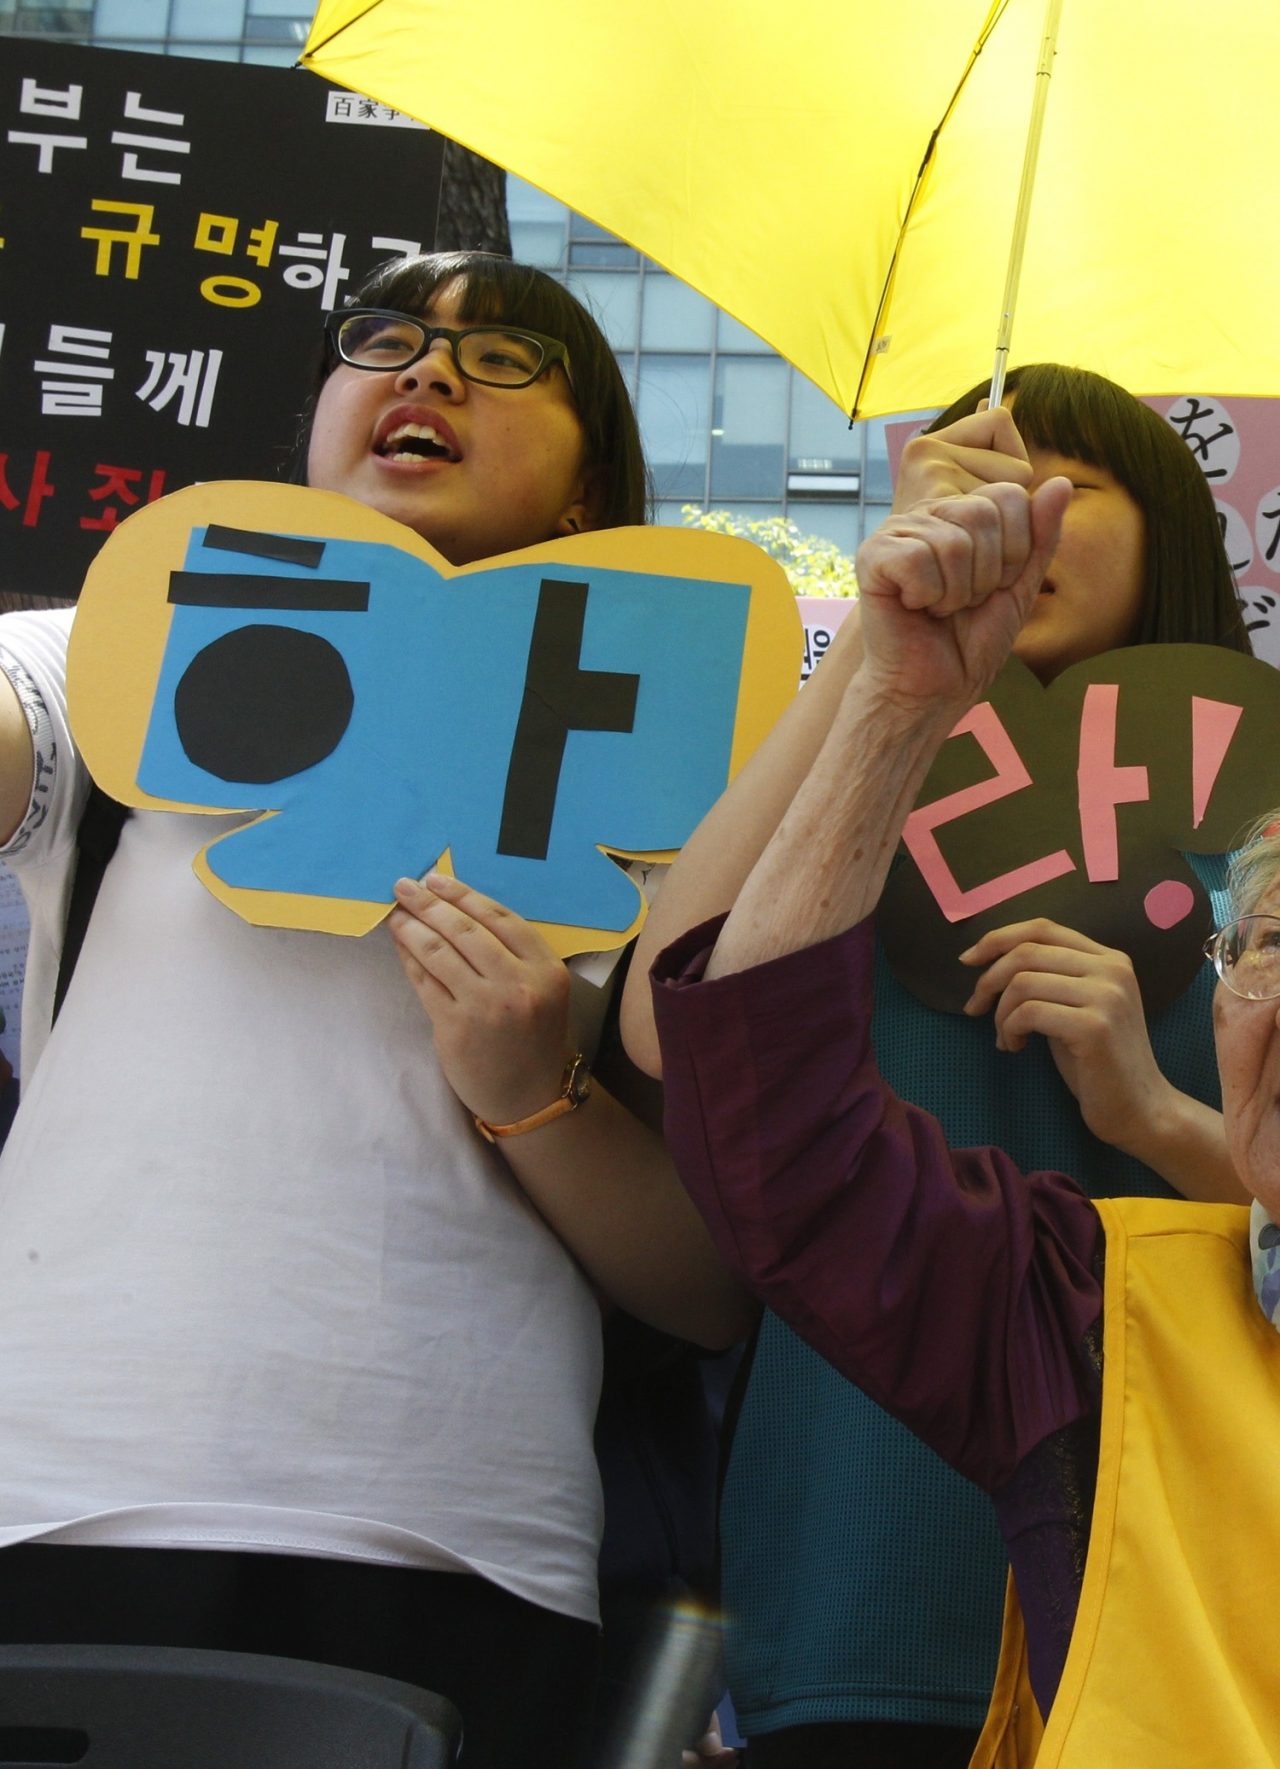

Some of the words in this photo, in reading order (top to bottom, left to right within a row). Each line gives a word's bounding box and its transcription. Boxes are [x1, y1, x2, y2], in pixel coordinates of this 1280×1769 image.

[8, 77, 191, 185] 부는
[333, 96, 414, 120] 百家
[0, 323, 223, 428] 들께
[167, 523, 641, 861] 하
